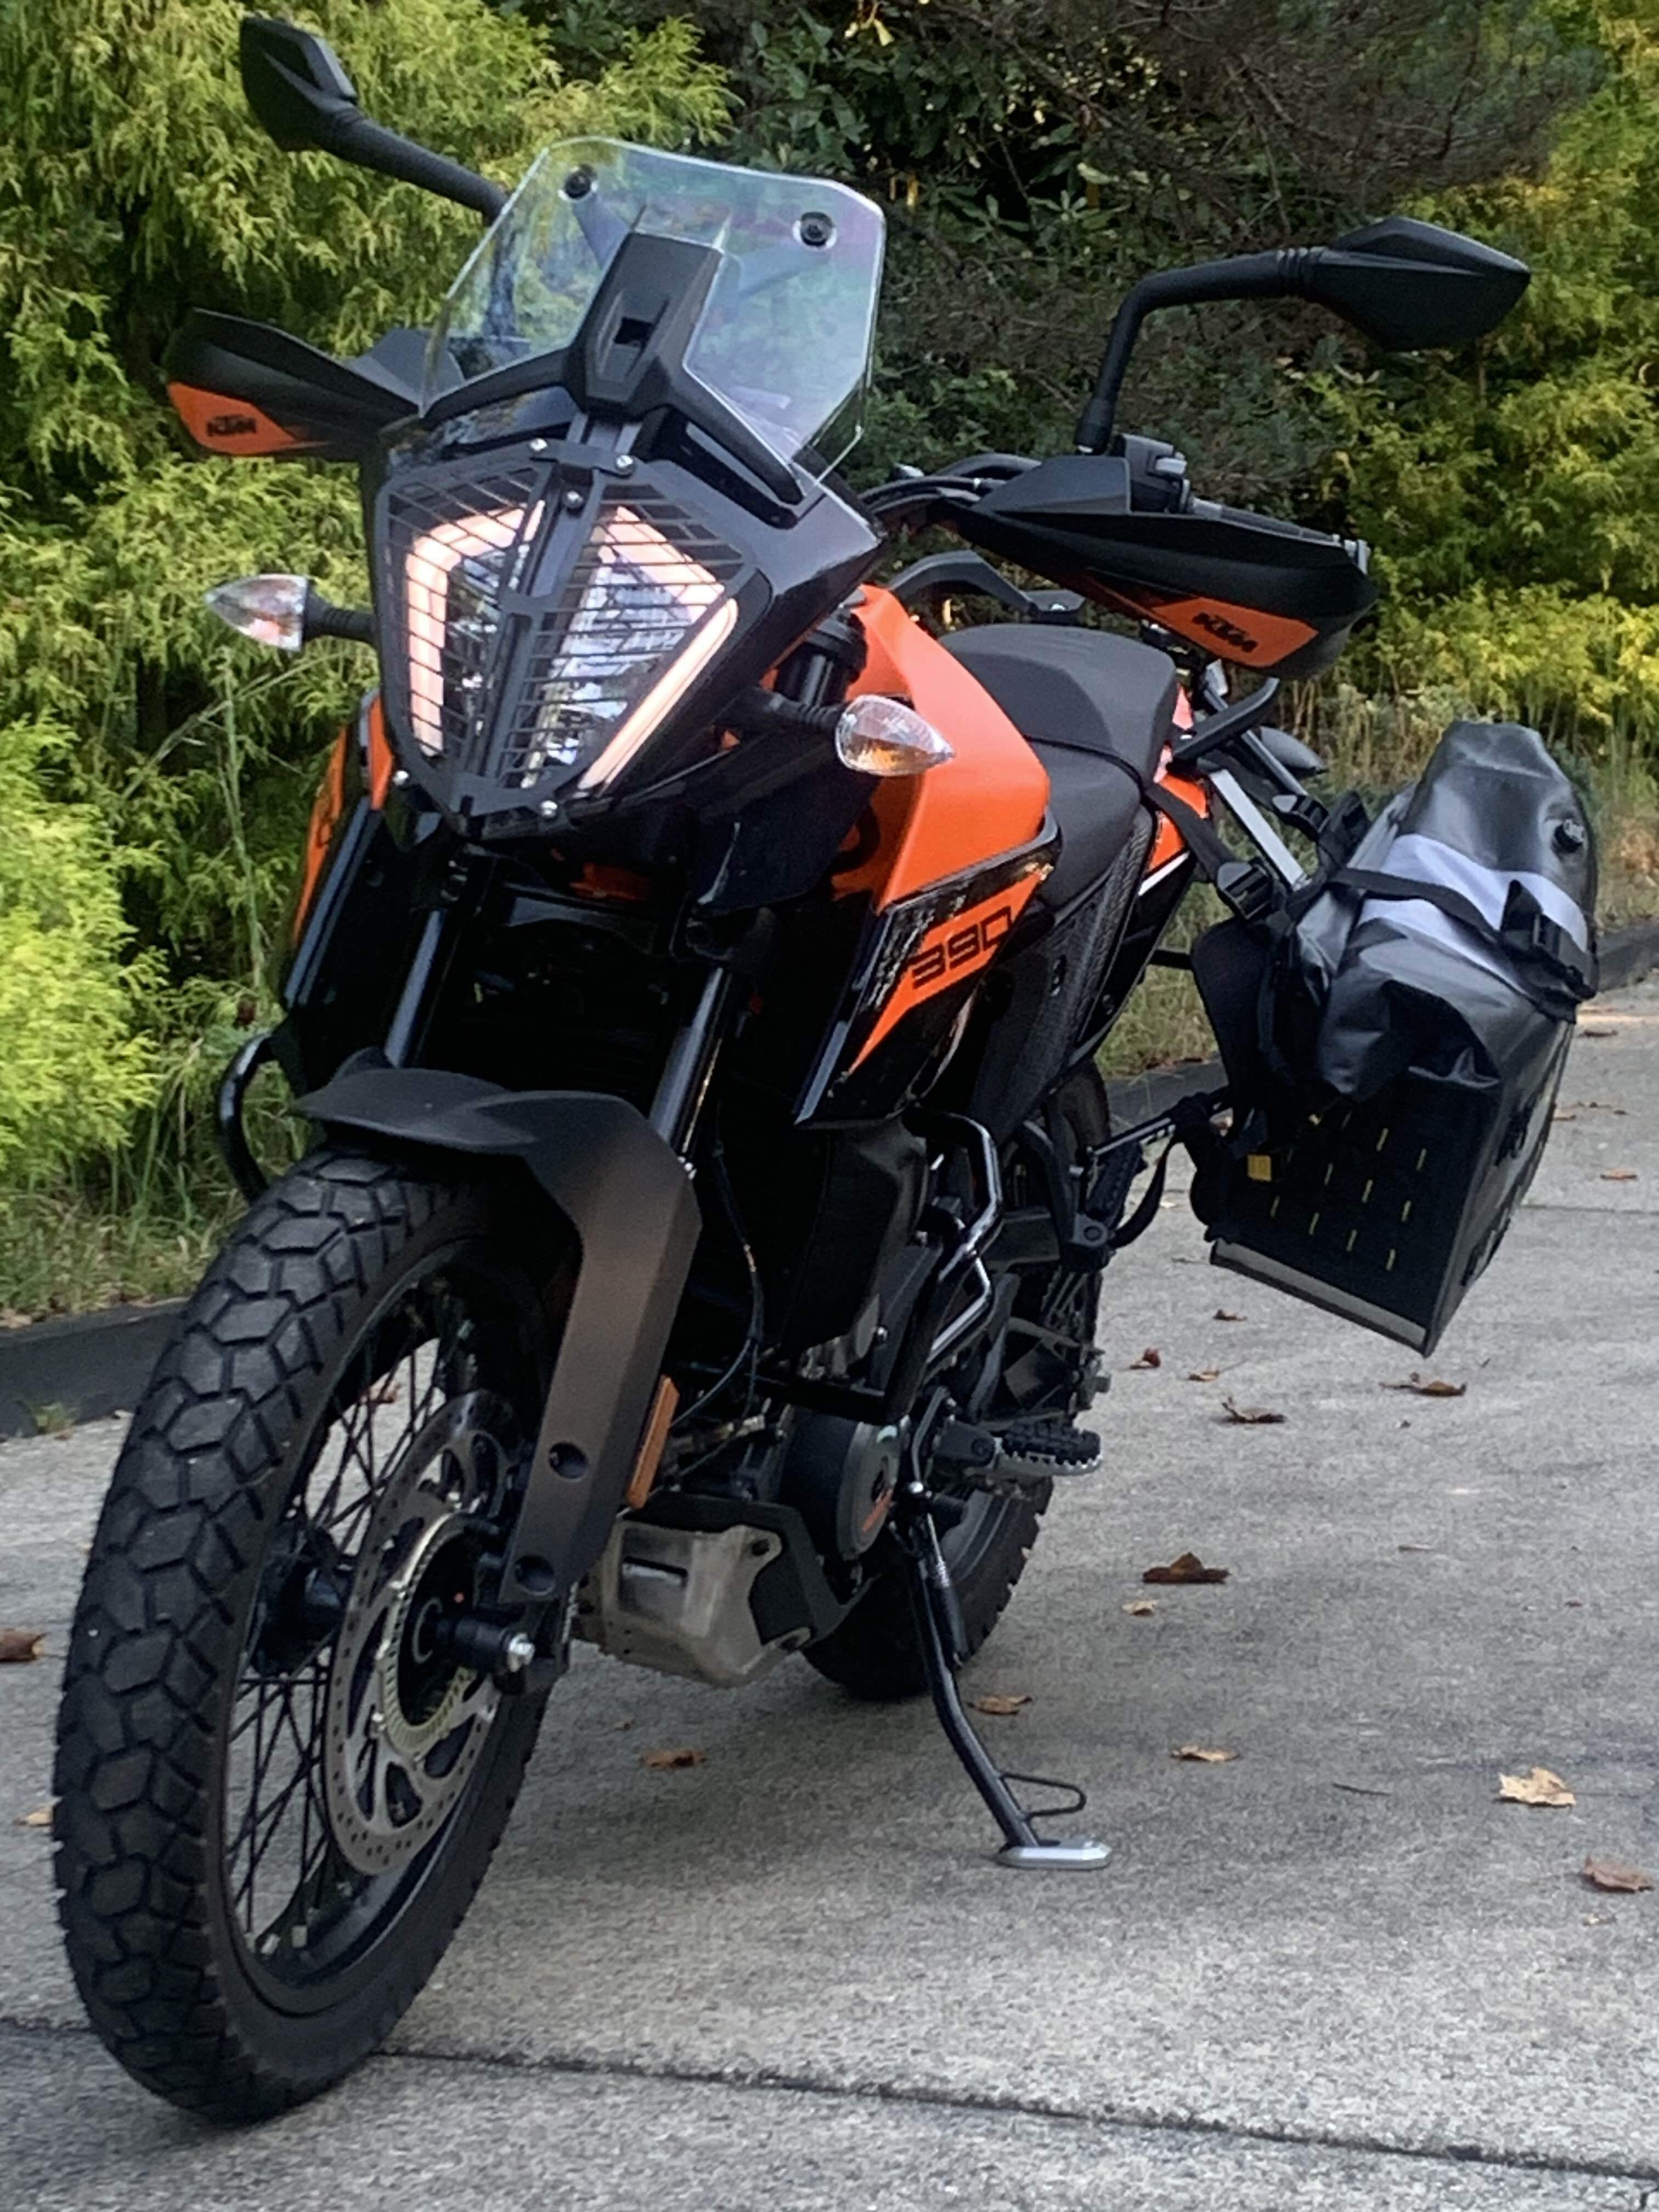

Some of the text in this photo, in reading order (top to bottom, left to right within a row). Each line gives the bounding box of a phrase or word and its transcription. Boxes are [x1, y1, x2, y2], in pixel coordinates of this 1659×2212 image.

[206, 414, 257, 437] KTM
[1192, 612, 1258, 653] KTM
[906, 906, 1013, 990] 390
